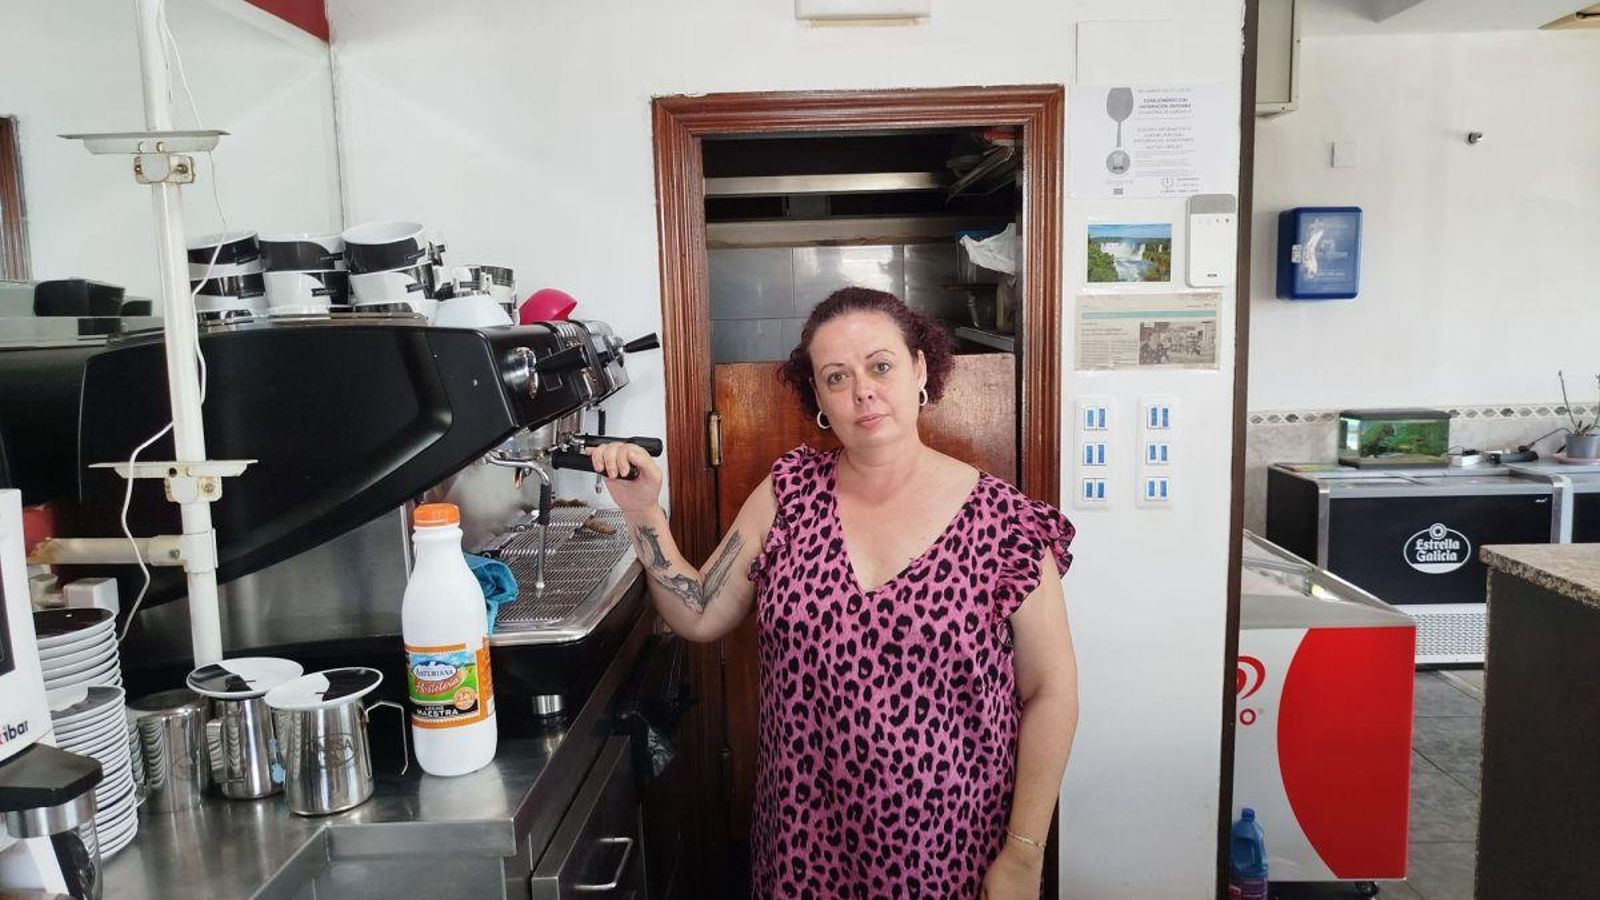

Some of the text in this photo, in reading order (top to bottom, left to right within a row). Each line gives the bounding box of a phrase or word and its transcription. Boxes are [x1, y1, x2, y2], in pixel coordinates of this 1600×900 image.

[1415, 539, 1460, 550] Estrella
[1416, 549, 1457, 562] Galicia
[416, 708, 459, 717] MAESTRA
